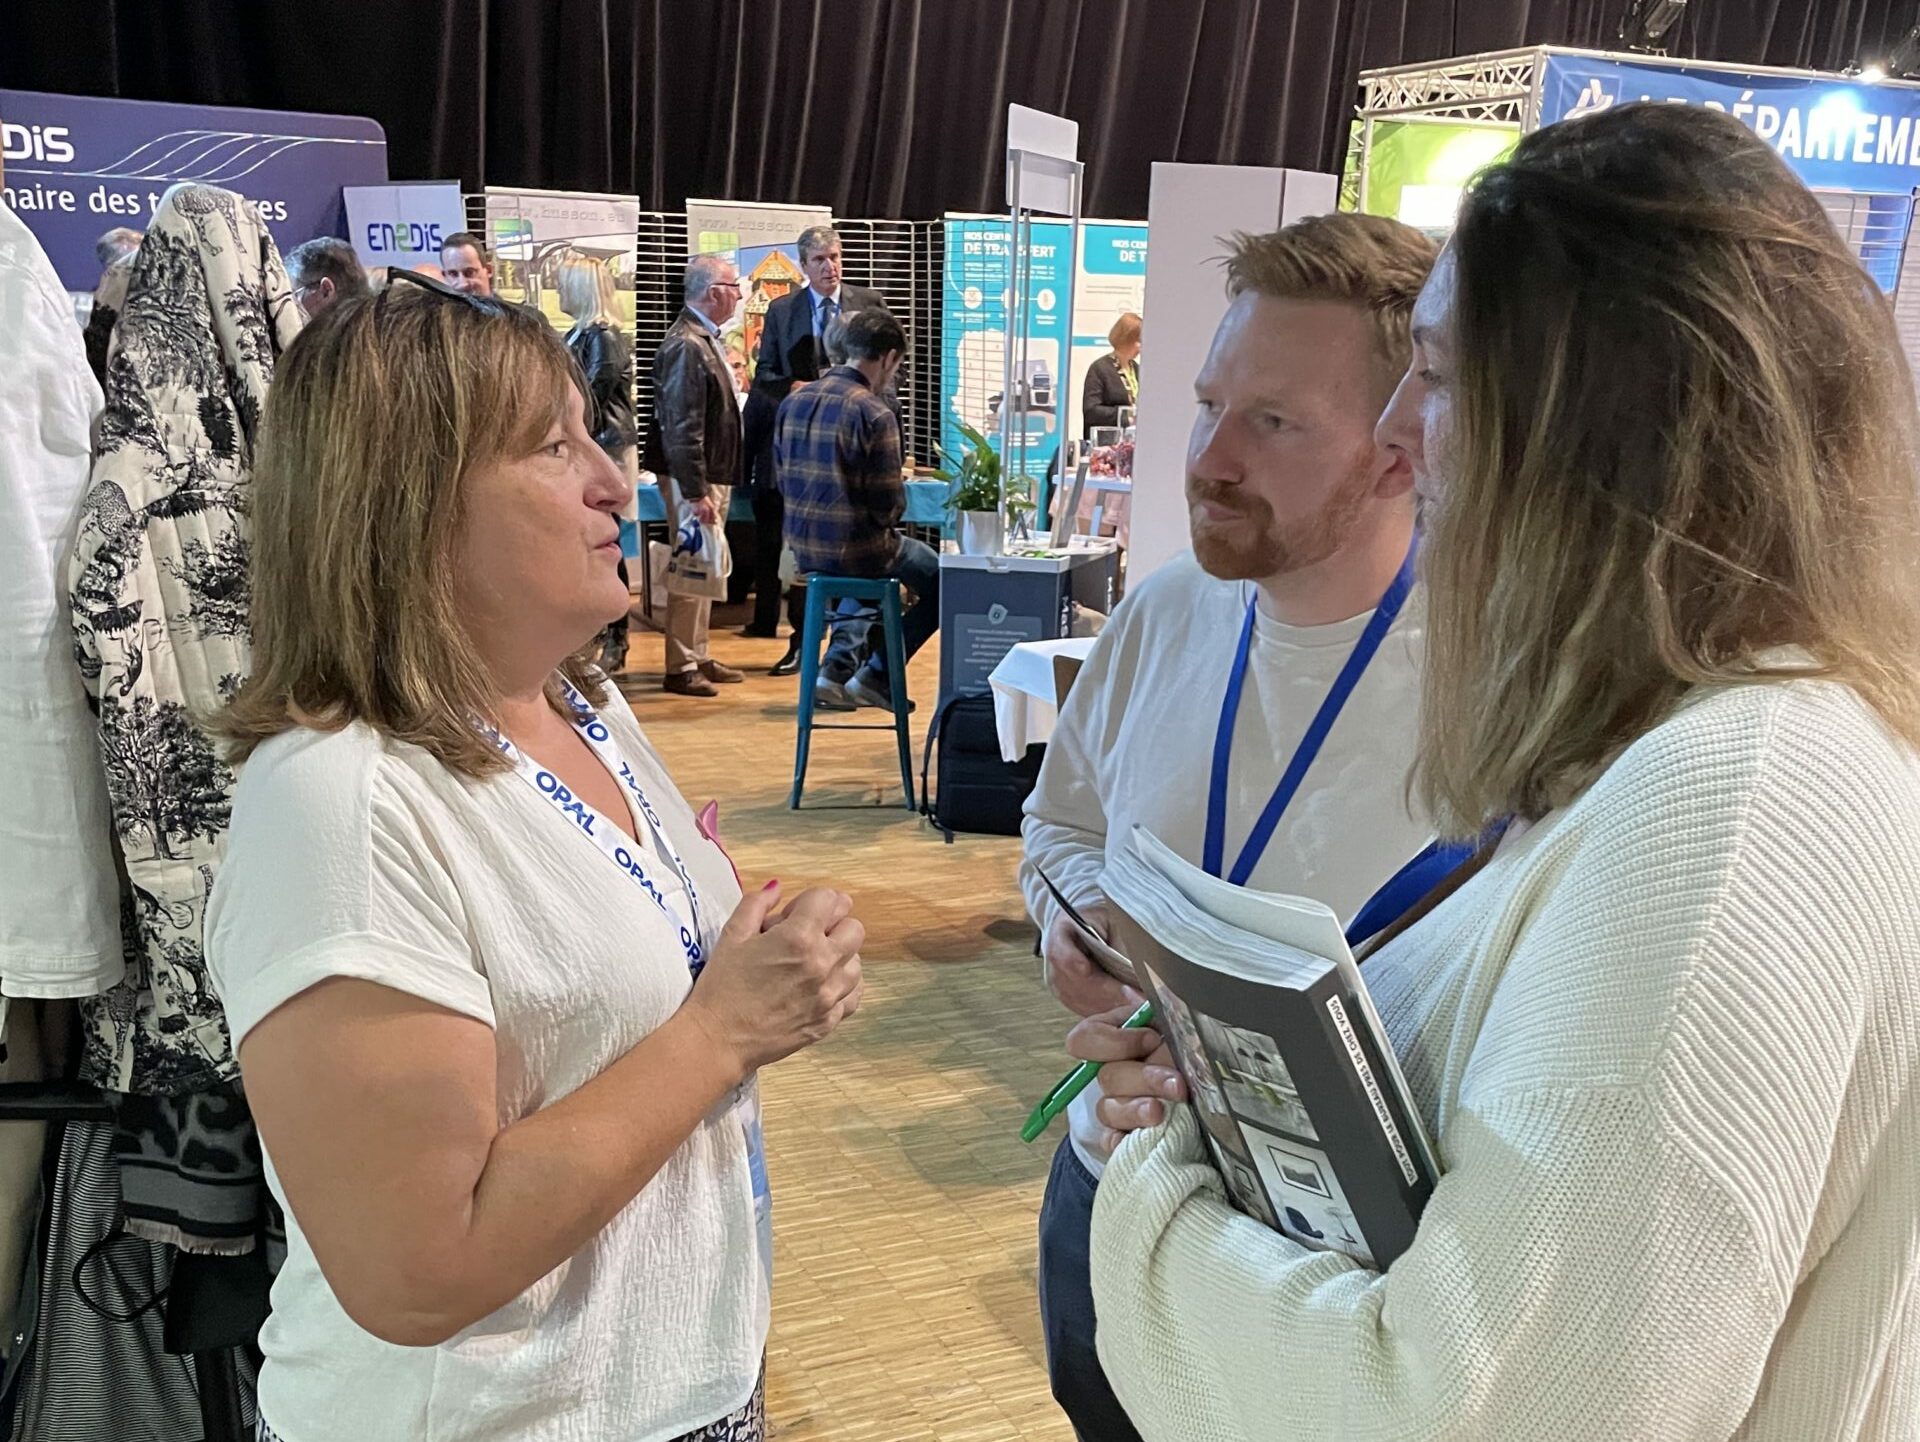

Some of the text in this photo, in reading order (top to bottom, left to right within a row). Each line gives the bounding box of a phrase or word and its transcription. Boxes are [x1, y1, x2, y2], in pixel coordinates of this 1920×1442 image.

[88, 185, 141, 214] des
[963, 242, 983, 256] DE
[1120, 249, 1137, 262] DE
[536, 771, 595, 836] OPAL
[614, 847, 667, 911] OPAL
[1329, 998, 1347, 1026] VOUS
[1342, 1026, 1358, 1051] CHEZ
[1353, 1050, 1364, 1065] DE
